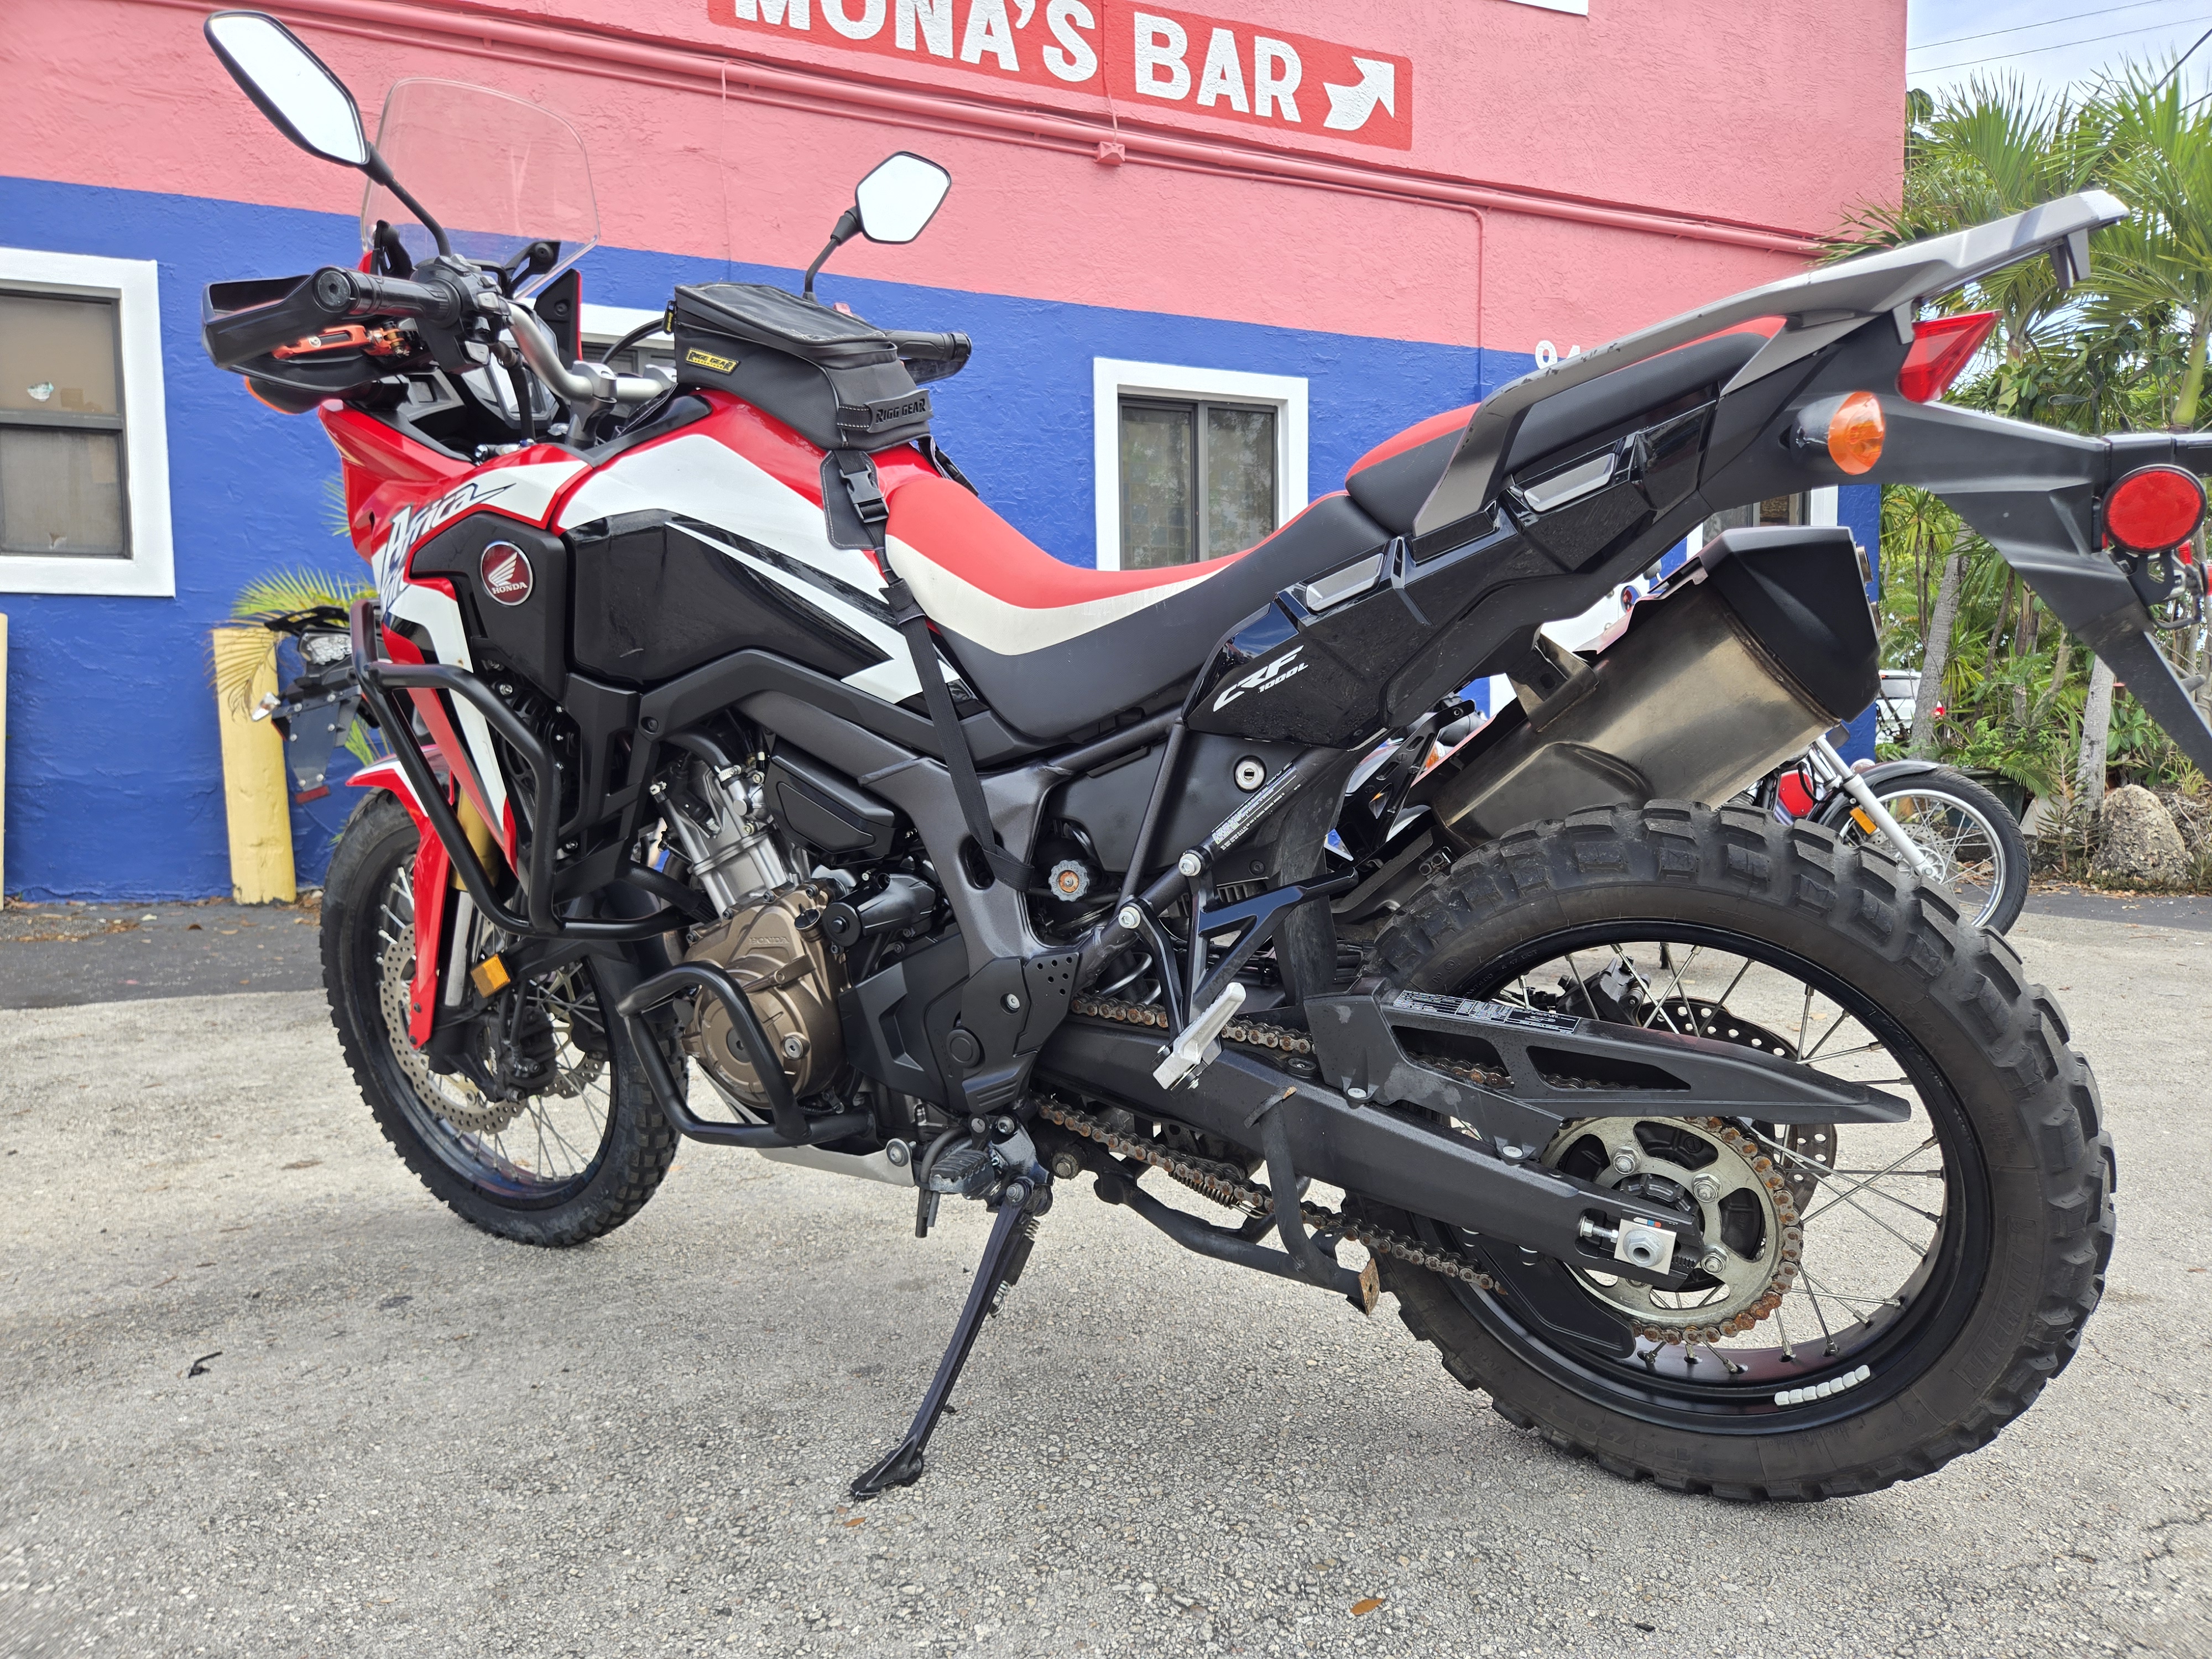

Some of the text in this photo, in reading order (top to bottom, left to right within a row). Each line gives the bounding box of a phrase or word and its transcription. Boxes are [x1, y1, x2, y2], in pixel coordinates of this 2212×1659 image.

[1133, 12, 1302, 123] BAR
[688, 351, 733, 371] RIGG GEAR
[875, 398, 926, 424] RIGG GEAR
[492, 582, 528, 595] HONDA
[1213, 645, 1304, 712] CRF
[1258, 662, 1309, 693] 1000L
[748, 936, 790, 945] HONDA
